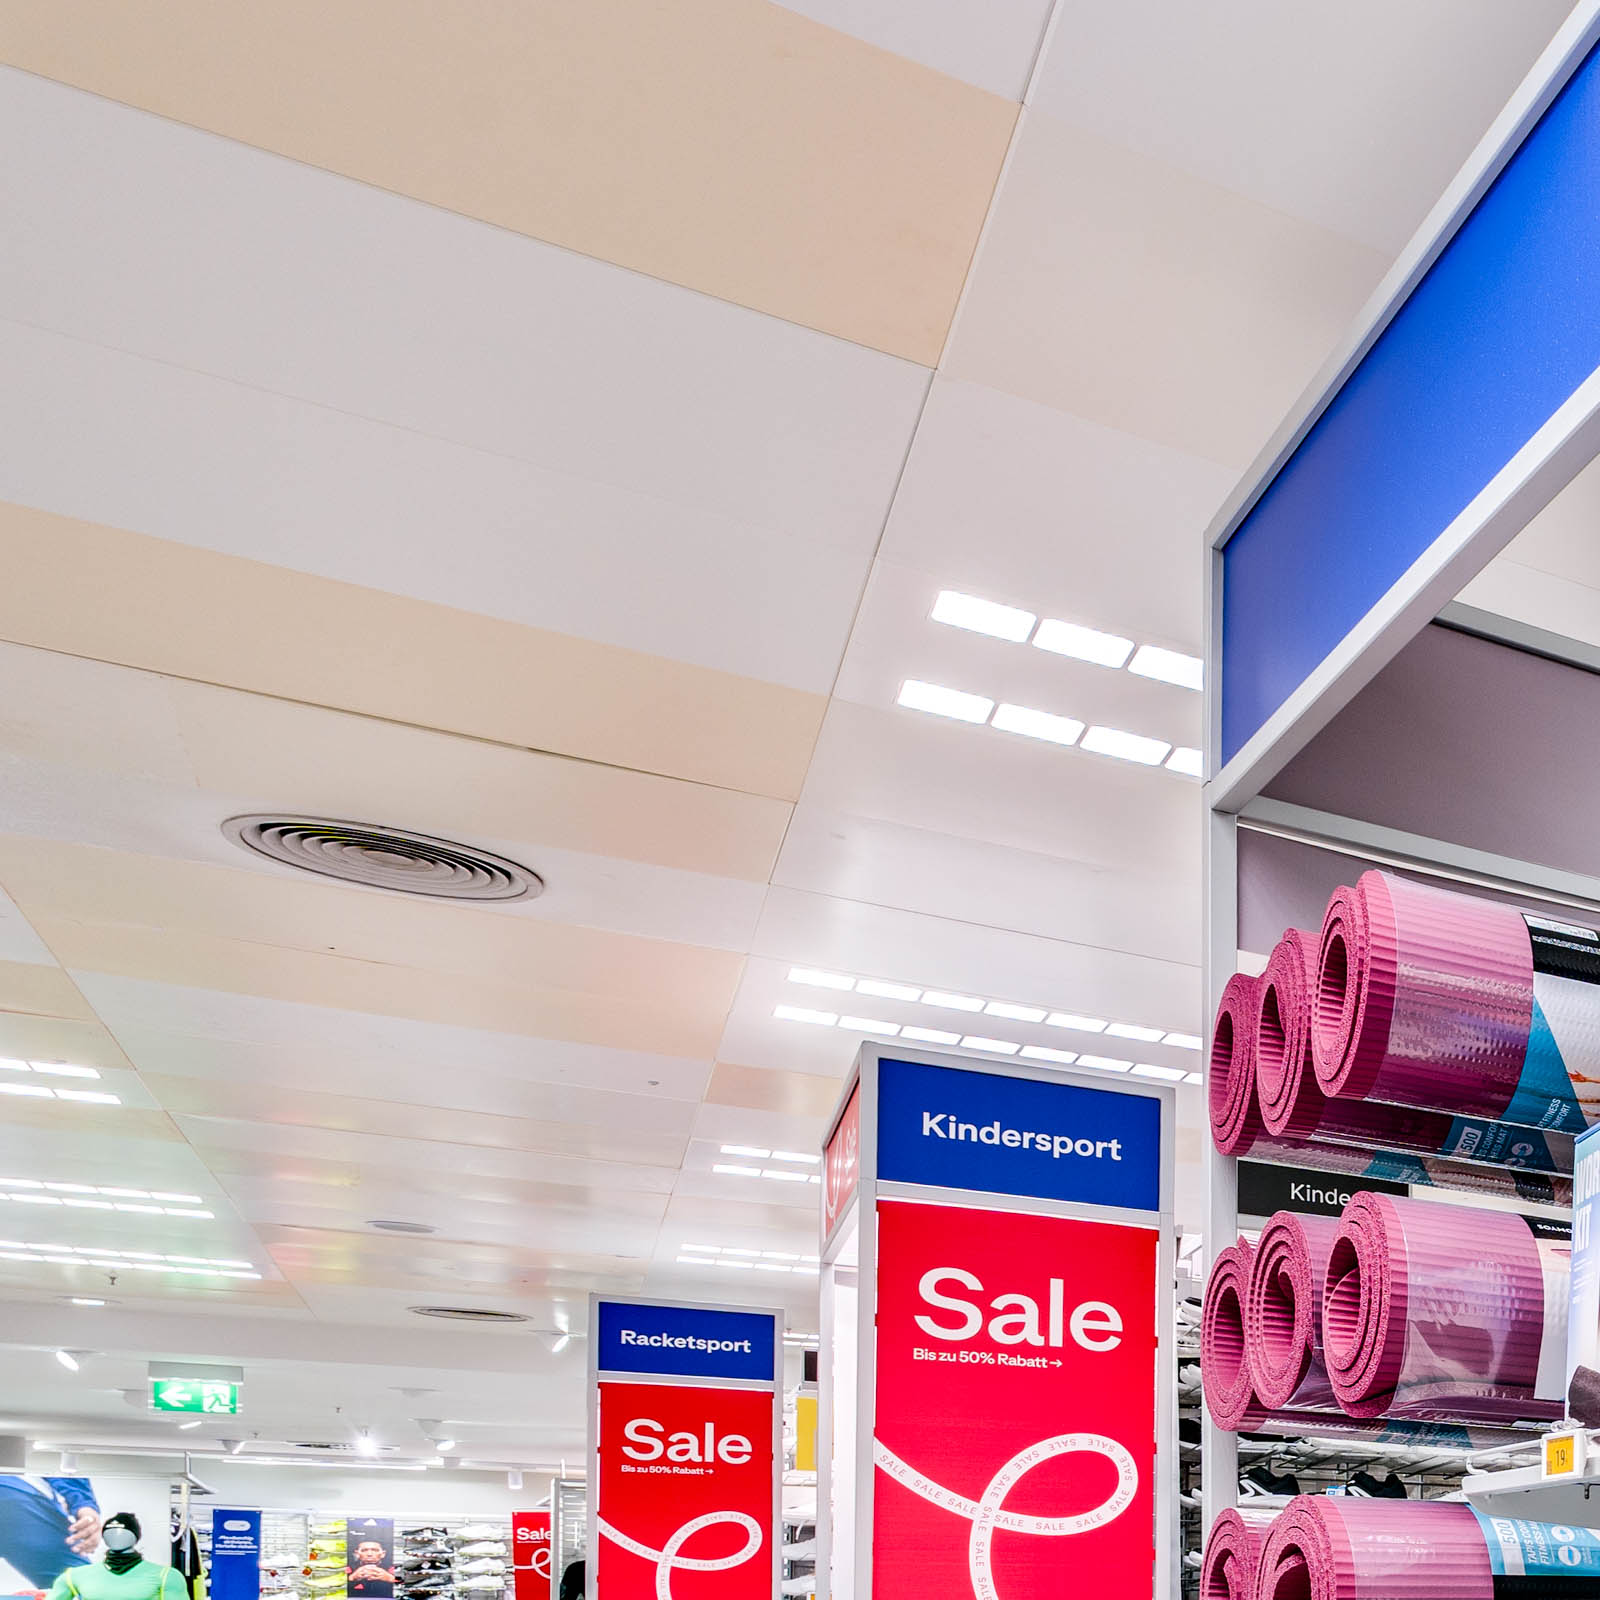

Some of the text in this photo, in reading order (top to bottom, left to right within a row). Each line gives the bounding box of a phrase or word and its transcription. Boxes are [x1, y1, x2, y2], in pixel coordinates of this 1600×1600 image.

[922, 1111, 1122, 1161] Kindersport
[1460, 1132, 1479, 1151] 500
[1290, 1182, 1351, 1206] Kinde
[913, 1266, 1124, 1352] Sale
[620, 1329, 752, 1354] Racketsport
[913, 1348, 1048, 1368] Bis zu 50% Rabatt
[621, 1418, 753, 1465] Sale
[1049, 1437, 1077, 1452] SALE
[1087, 1438, 1115, 1453] SALE
[621, 1464, 704, 1476] Bis zu 50% Rabatt
[879, 1454, 906, 1477] SALE
[1015, 1449, 1040, 1471] SALE
[1120, 1455, 1133, 1481] SALE
[913, 1479, 942, 1499] SALE
[990, 1473, 1010, 1498] SALE
[947, 1497, 977, 1515] SALE
[1110, 1489, 1131, 1512] SALE
[977, 1505, 993, 1532] SALE
[994, 1514, 1024, 1528] SALE
[1035, 1521, 1065, 1531] SALE
[1075, 1512, 1103, 1528] SALE
[517, 1527, 551, 1540] Sale
[975, 1541, 985, 1567] SALE
